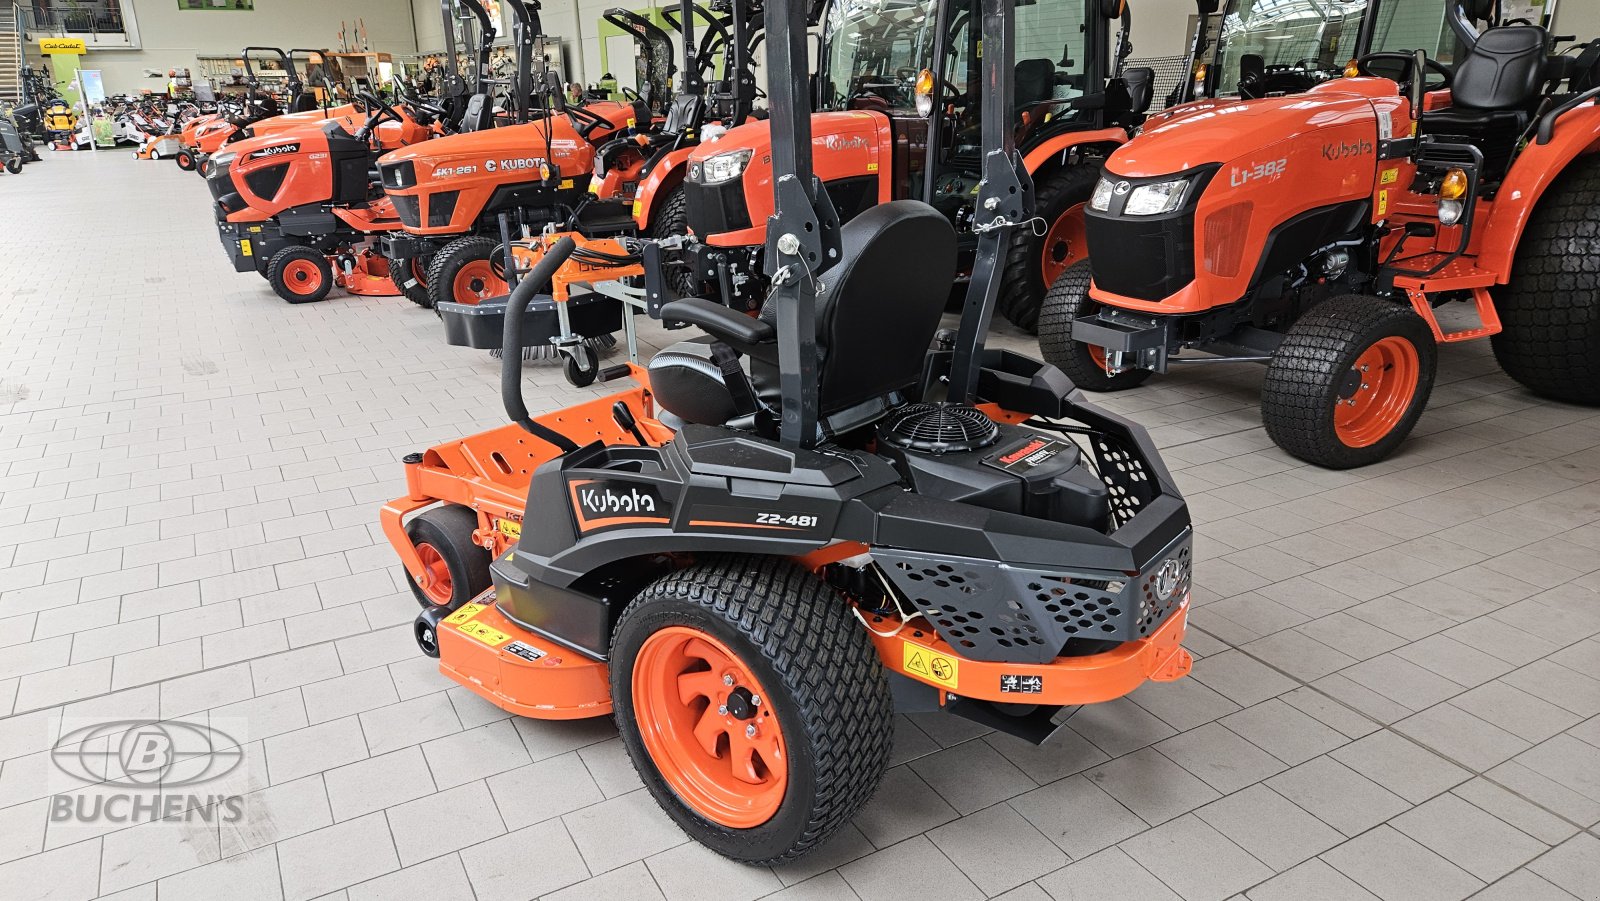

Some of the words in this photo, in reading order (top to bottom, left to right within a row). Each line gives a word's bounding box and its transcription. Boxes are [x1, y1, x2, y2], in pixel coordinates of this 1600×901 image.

[264, 144, 297, 155] Kubota
[1322, 138, 1373, 160] Kubota
[1230, 158, 1287, 187] L1-382
[999, 439, 1047, 464] Kawasaki
[581, 488, 656, 513] Kubota
[755, 512, 818, 527] Z2-481
